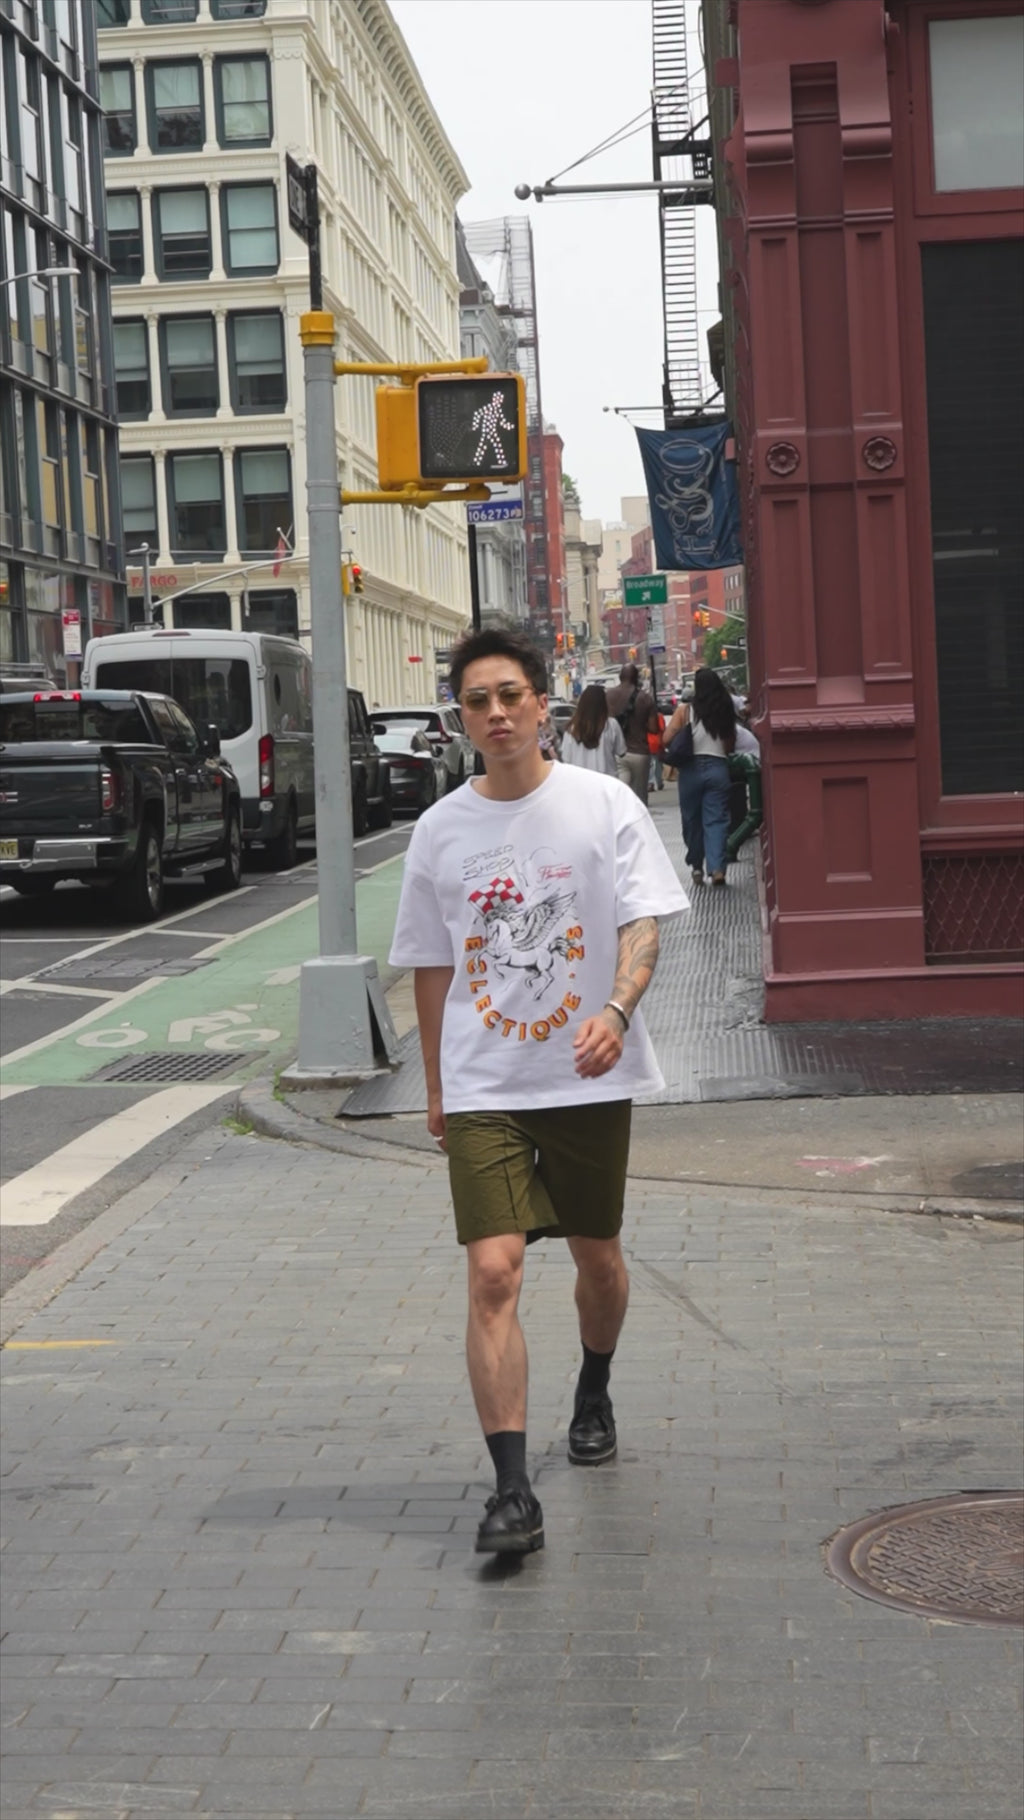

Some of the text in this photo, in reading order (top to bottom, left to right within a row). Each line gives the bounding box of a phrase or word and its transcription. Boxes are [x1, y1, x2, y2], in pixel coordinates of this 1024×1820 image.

[468, 508, 510, 521] 106273
[626, 580, 664, 589] Broadway
[462, 844, 514, 869] SPEED
[463, 857, 515, 881] SHOP
[465, 936, 582, 1041] ECLECTIQUE
